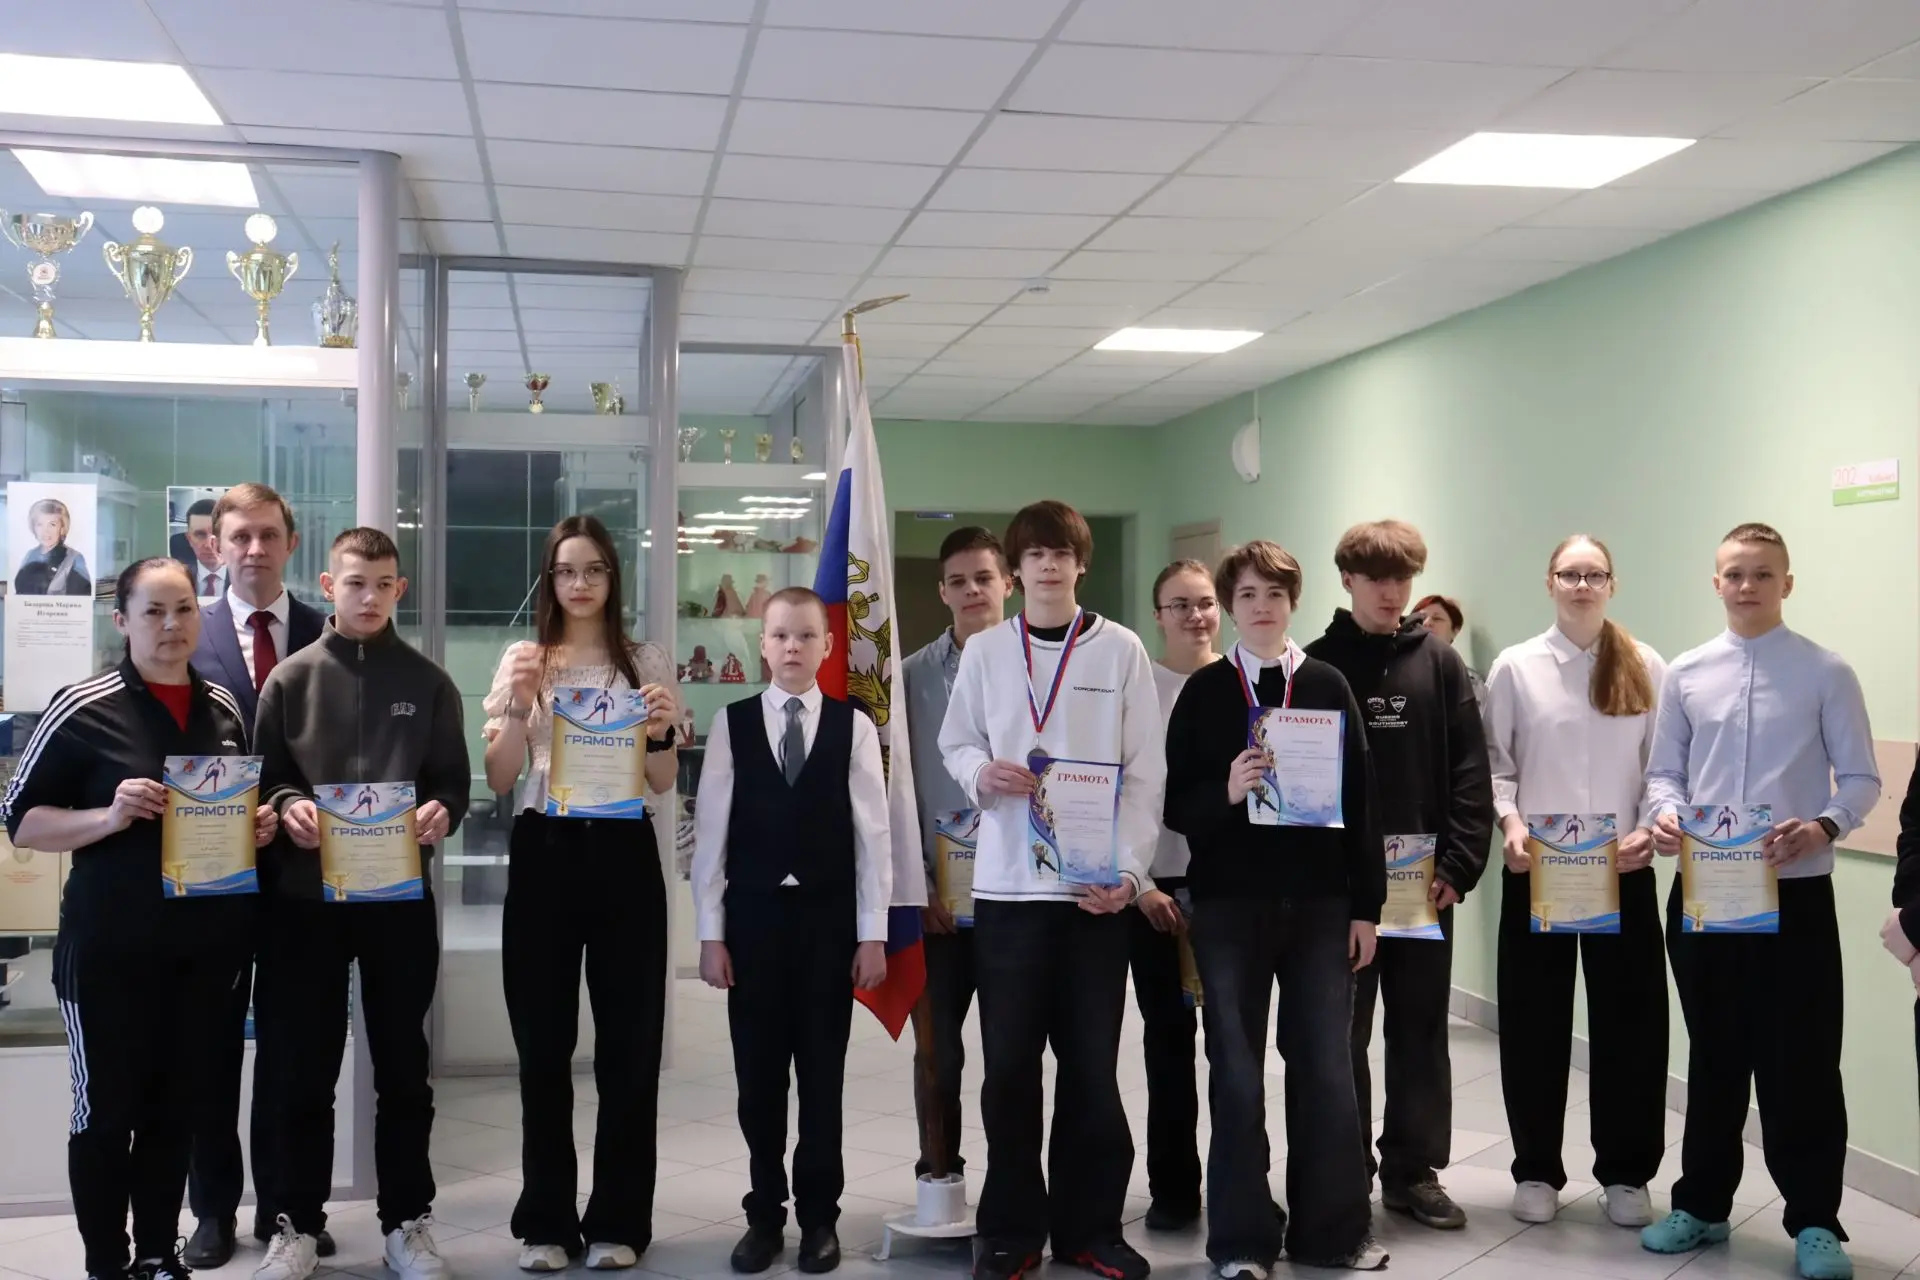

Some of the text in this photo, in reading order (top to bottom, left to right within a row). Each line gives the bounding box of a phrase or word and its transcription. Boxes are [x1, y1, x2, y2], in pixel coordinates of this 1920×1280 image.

[390, 702, 416, 716] GAP
[1278, 715, 1333, 726] ГРАМОТА
[564, 734, 635, 748] ГРАМОТА
[1057, 772, 1110, 785] ГРАМОТА
[175, 805, 247, 818] ГРАМОТА
[331, 824, 407, 837] ГРАМОТА
[947, 850, 977, 861] ГРА
[1541, 855, 1608, 866] ГРАМОТА
[1692, 850, 1763, 861] ГРАМОТА
[1386, 871, 1424, 881] МОТА
